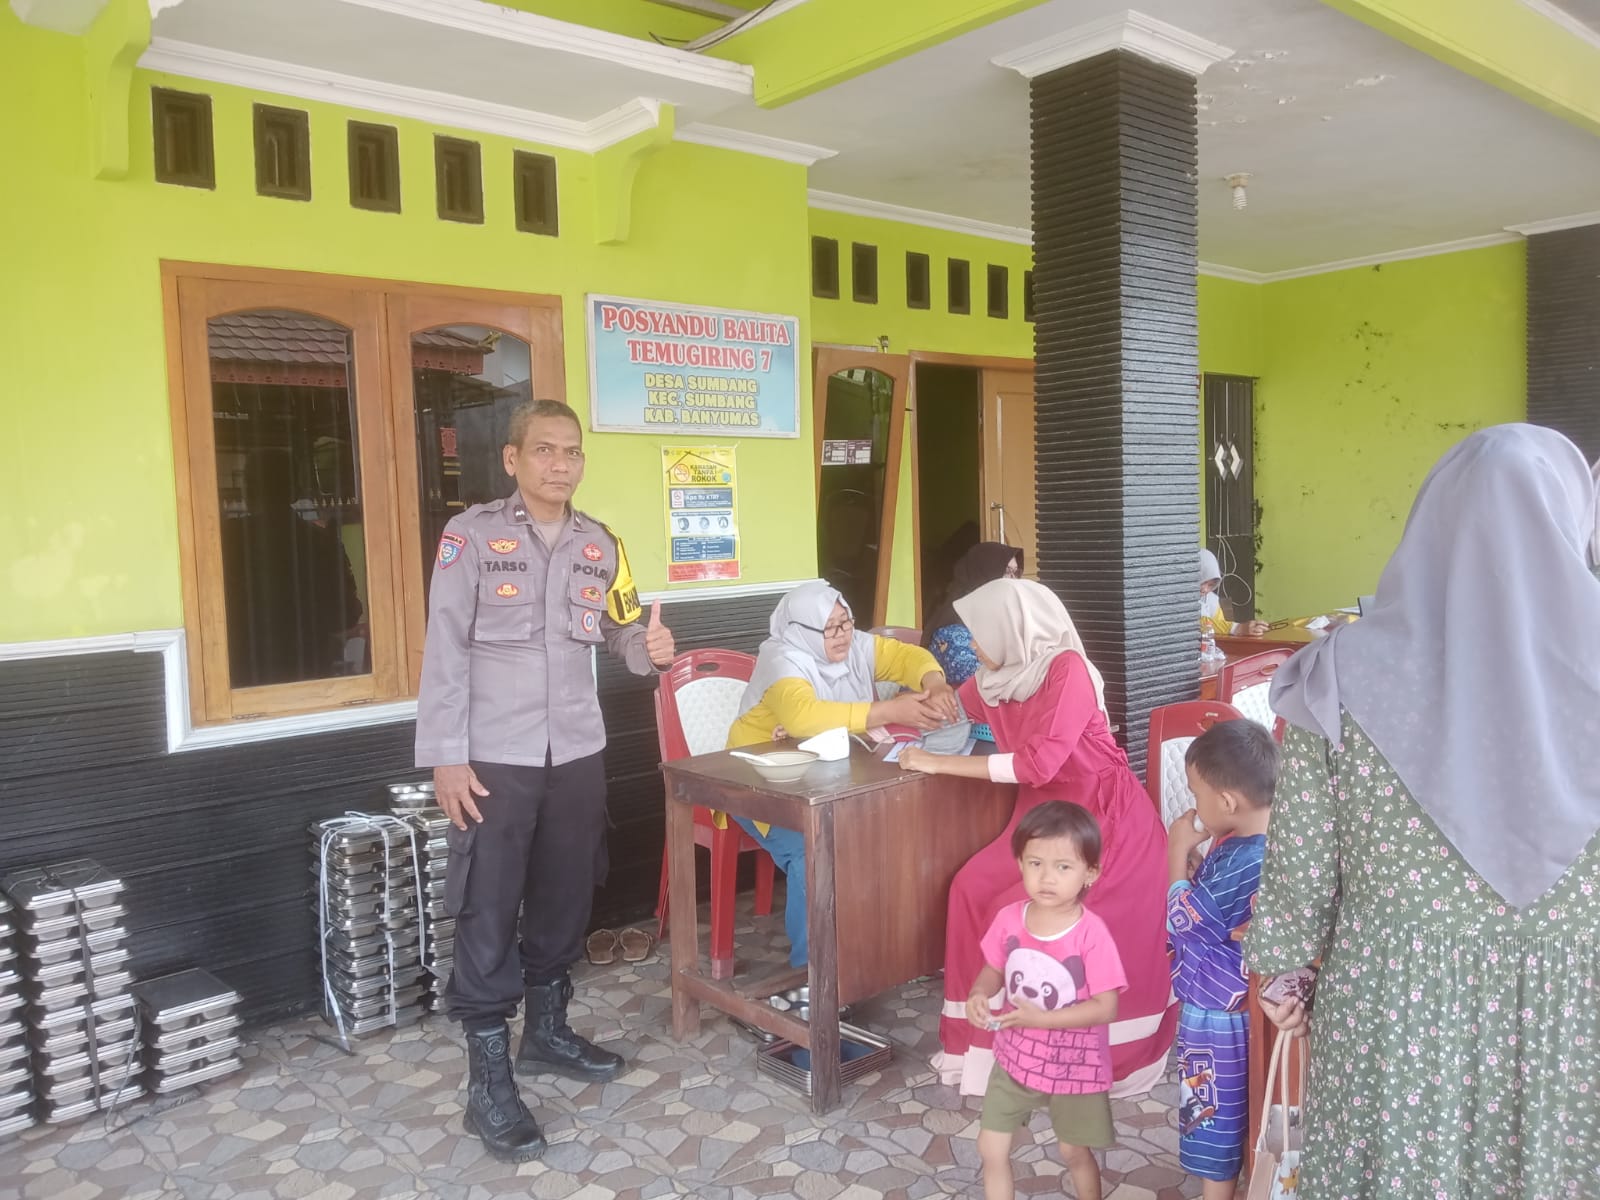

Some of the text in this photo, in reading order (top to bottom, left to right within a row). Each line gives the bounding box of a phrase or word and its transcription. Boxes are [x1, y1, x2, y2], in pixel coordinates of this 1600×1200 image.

[602, 306, 789, 344] POSYANDU BALITA
[627, 340, 772, 371] TEMUGIRING 7
[644, 373, 758, 393] DESA SUMBANG
[648, 390, 757, 409] KEC. SUMBANG
[644, 408, 760, 426] KAB. BANYUMAS
[484, 560, 528, 573] TARSO
